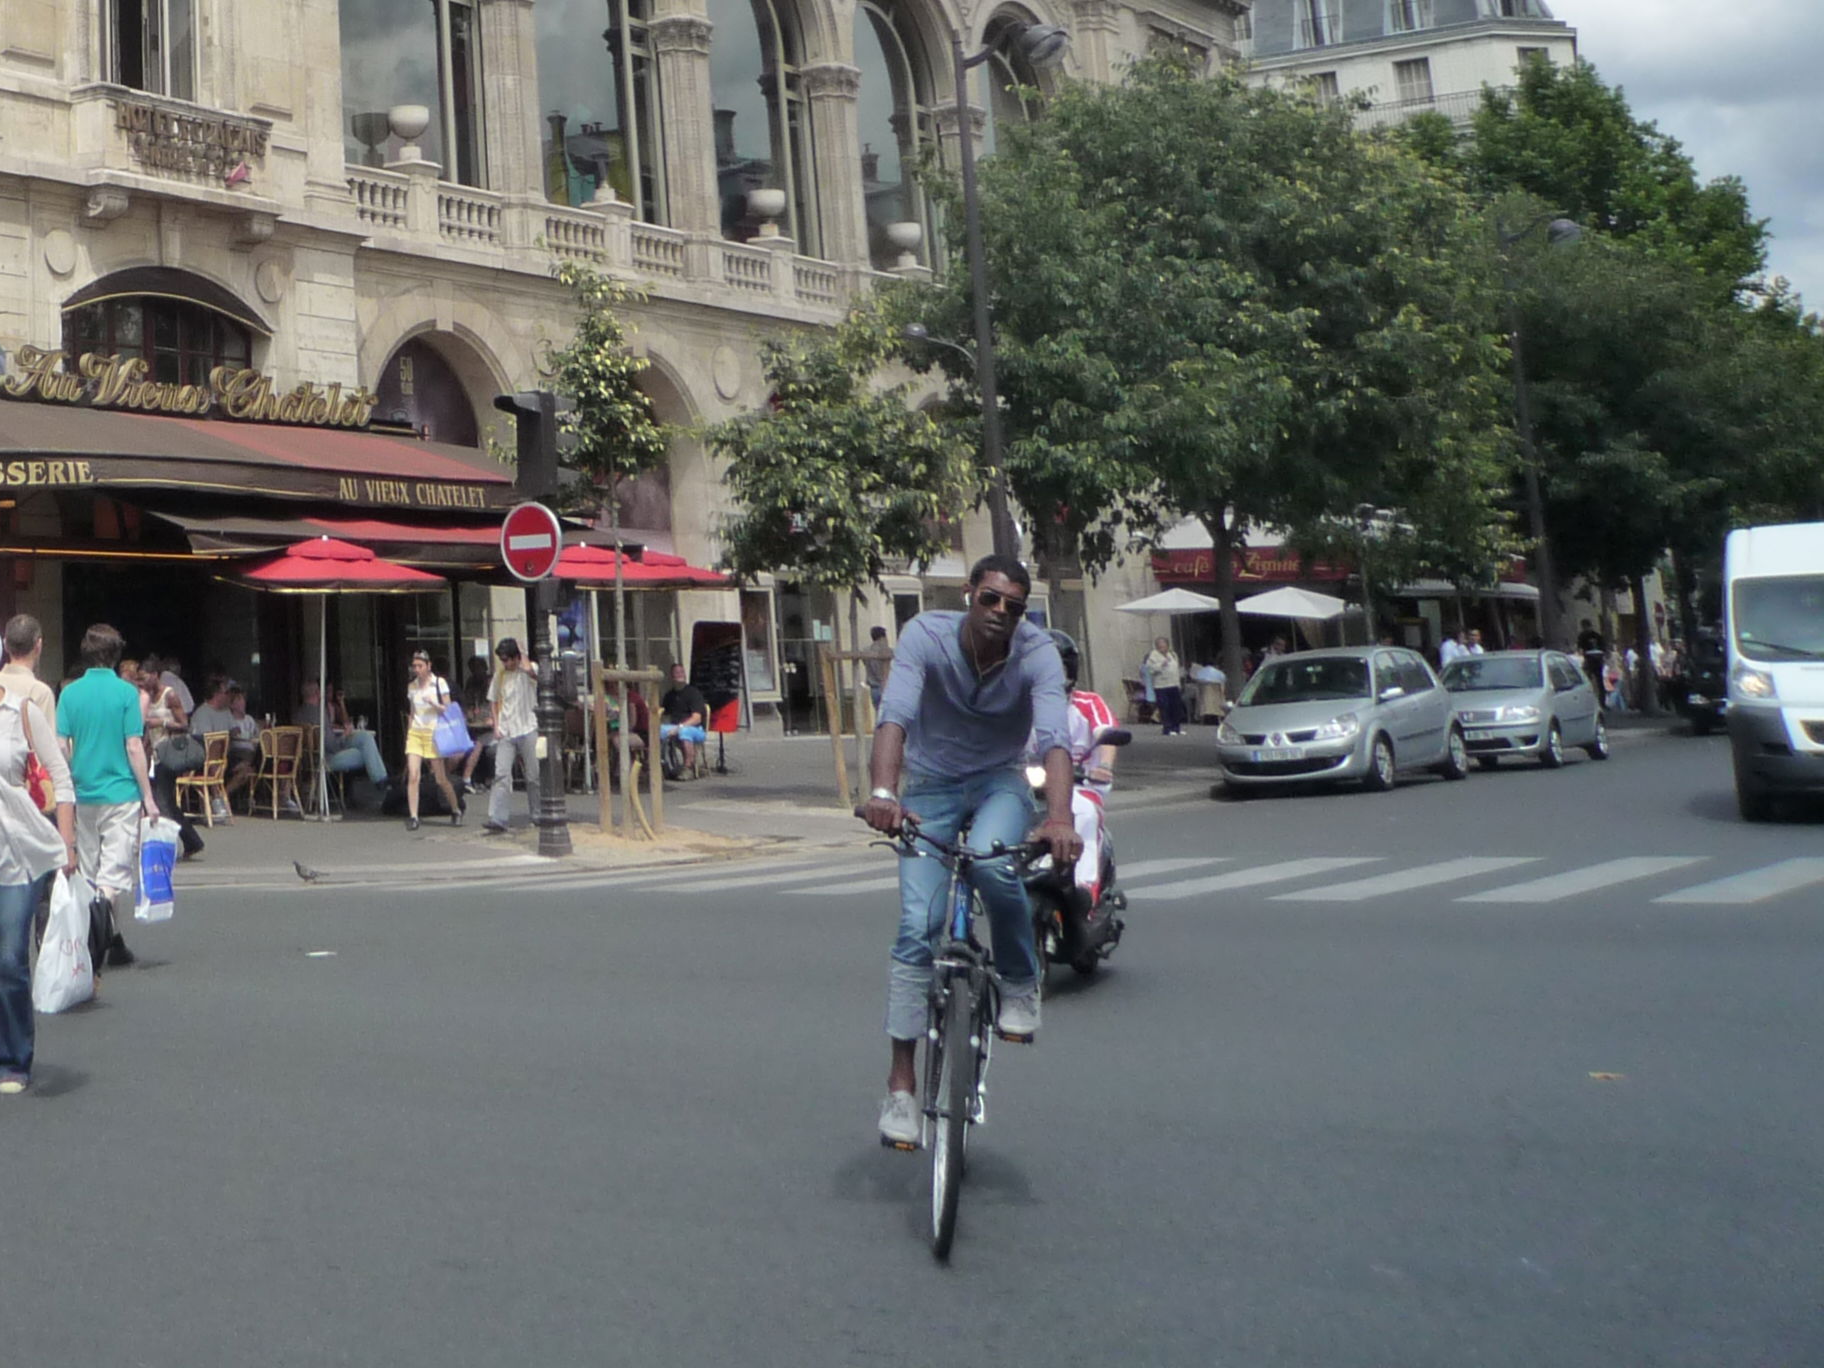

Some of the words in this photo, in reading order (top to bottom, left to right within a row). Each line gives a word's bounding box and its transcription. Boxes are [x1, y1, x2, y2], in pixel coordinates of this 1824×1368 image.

[78, 352, 214, 414] Vieux
[339, 477, 359, 501] AU
[365, 480, 410, 504] VIEUX
[416, 483, 485, 509] CHATELET
